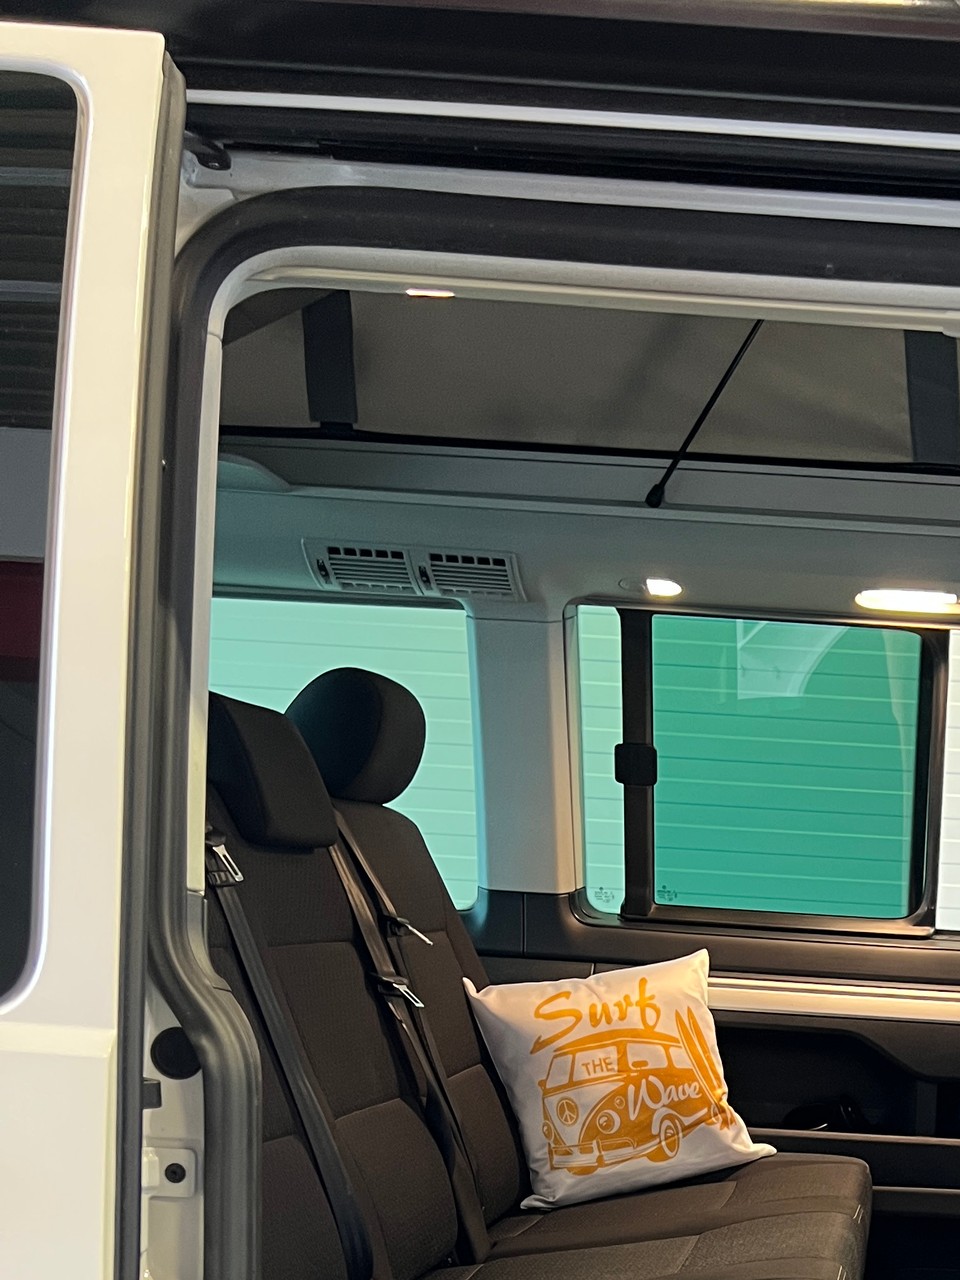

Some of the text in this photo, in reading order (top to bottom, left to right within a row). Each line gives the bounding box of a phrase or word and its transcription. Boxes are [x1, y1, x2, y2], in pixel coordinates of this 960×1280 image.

[531, 977, 661, 1054] Surf
[582, 1056, 614, 1076] THE
[626, 1075, 702, 1119] Wave
